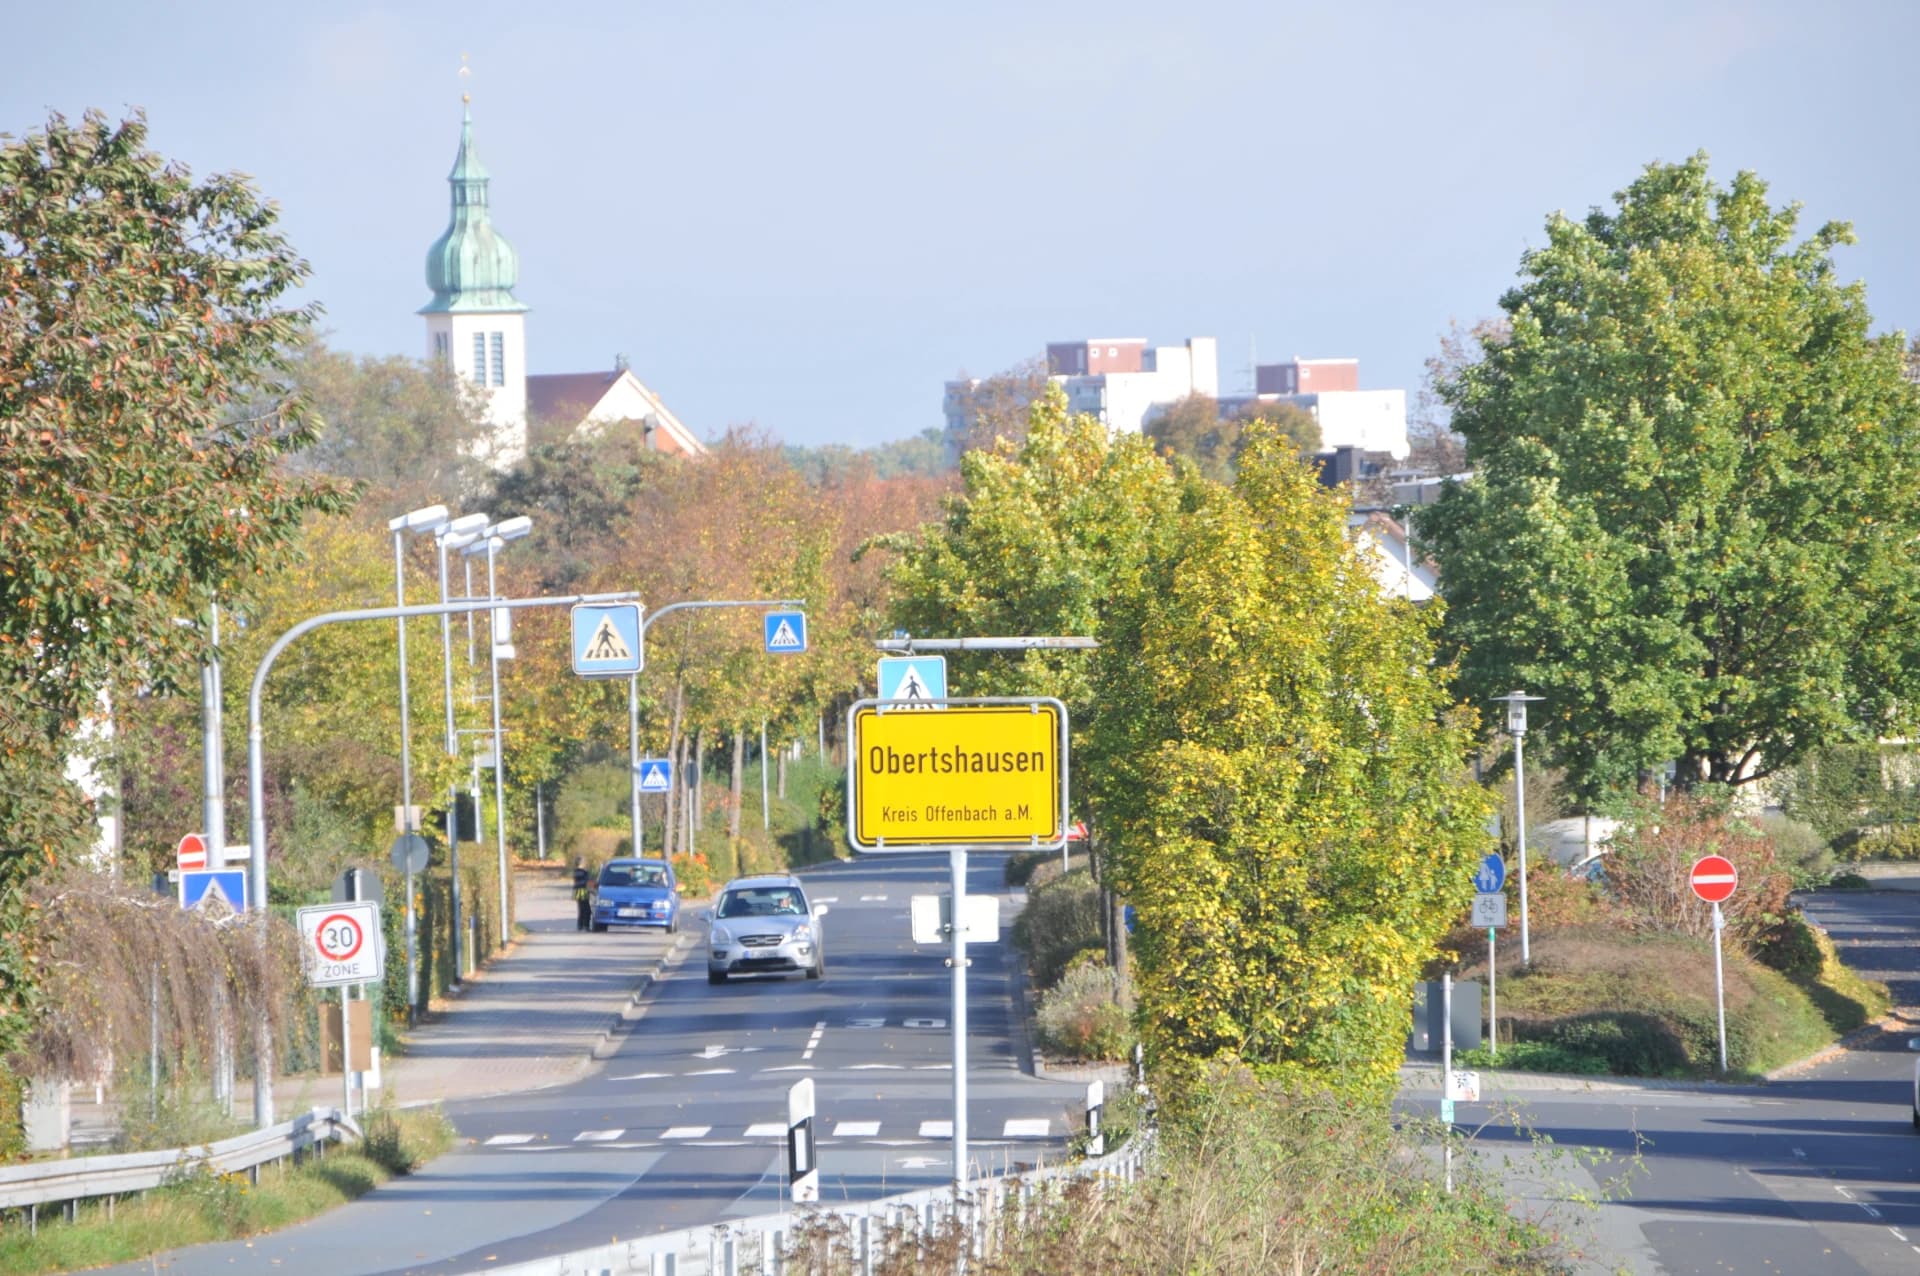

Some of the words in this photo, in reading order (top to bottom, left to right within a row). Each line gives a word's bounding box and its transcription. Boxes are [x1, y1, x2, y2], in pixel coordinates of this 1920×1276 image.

[870, 745, 1044, 774] Obertshausen
[883, 806, 918, 822] Kreis
[926, 805, 997, 821] Offenbach
[326, 926, 352, 948] 30
[324, 963, 361, 977] ZONE
